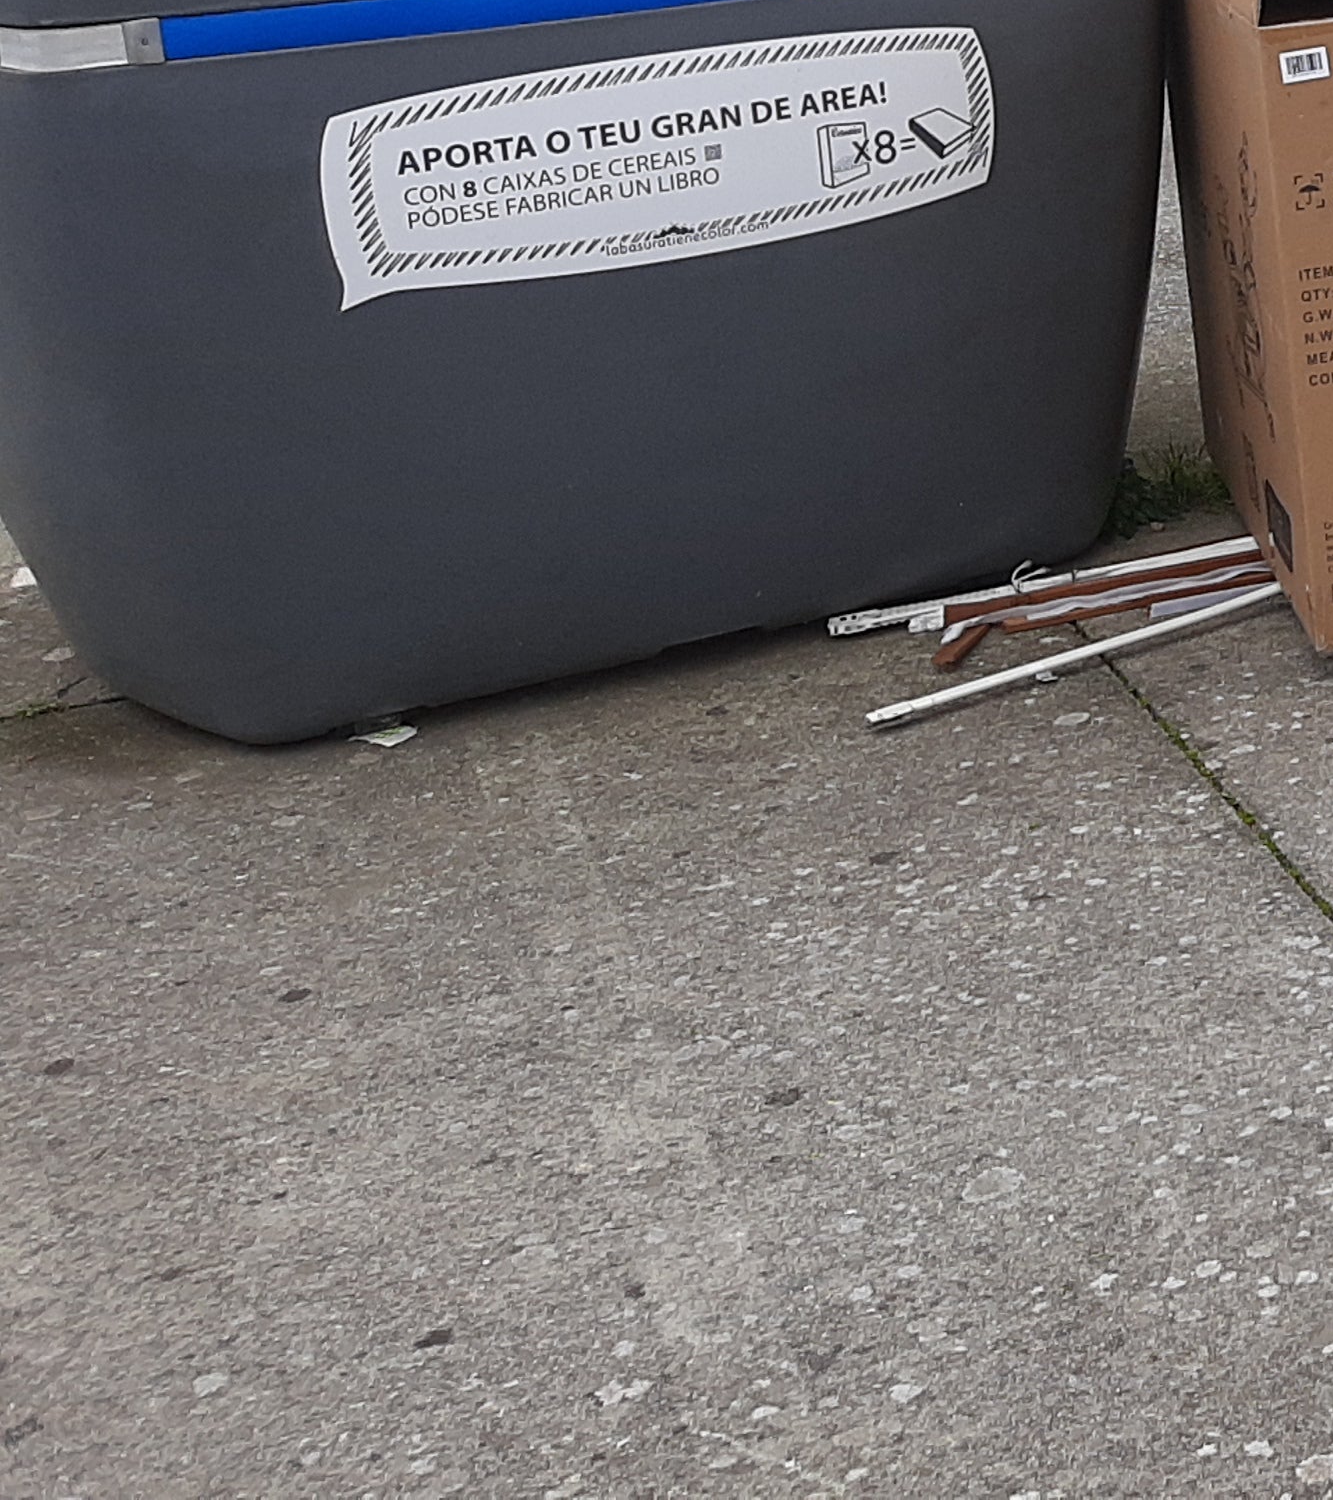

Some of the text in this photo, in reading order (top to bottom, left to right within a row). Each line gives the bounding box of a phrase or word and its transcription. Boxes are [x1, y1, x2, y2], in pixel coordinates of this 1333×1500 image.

[397, 82, 887, 176] APORTA O TEU GRAN DE AREA!
[404, 148, 696, 206] CON 8 CAIXAS DE CEREAIS
[407, 167, 720, 229] PÓDESE FABRICAR UN LIBRO
[606, 222, 769, 256] labasuratienecolor.com
[1299, 266, 1333, 281] ITEM
